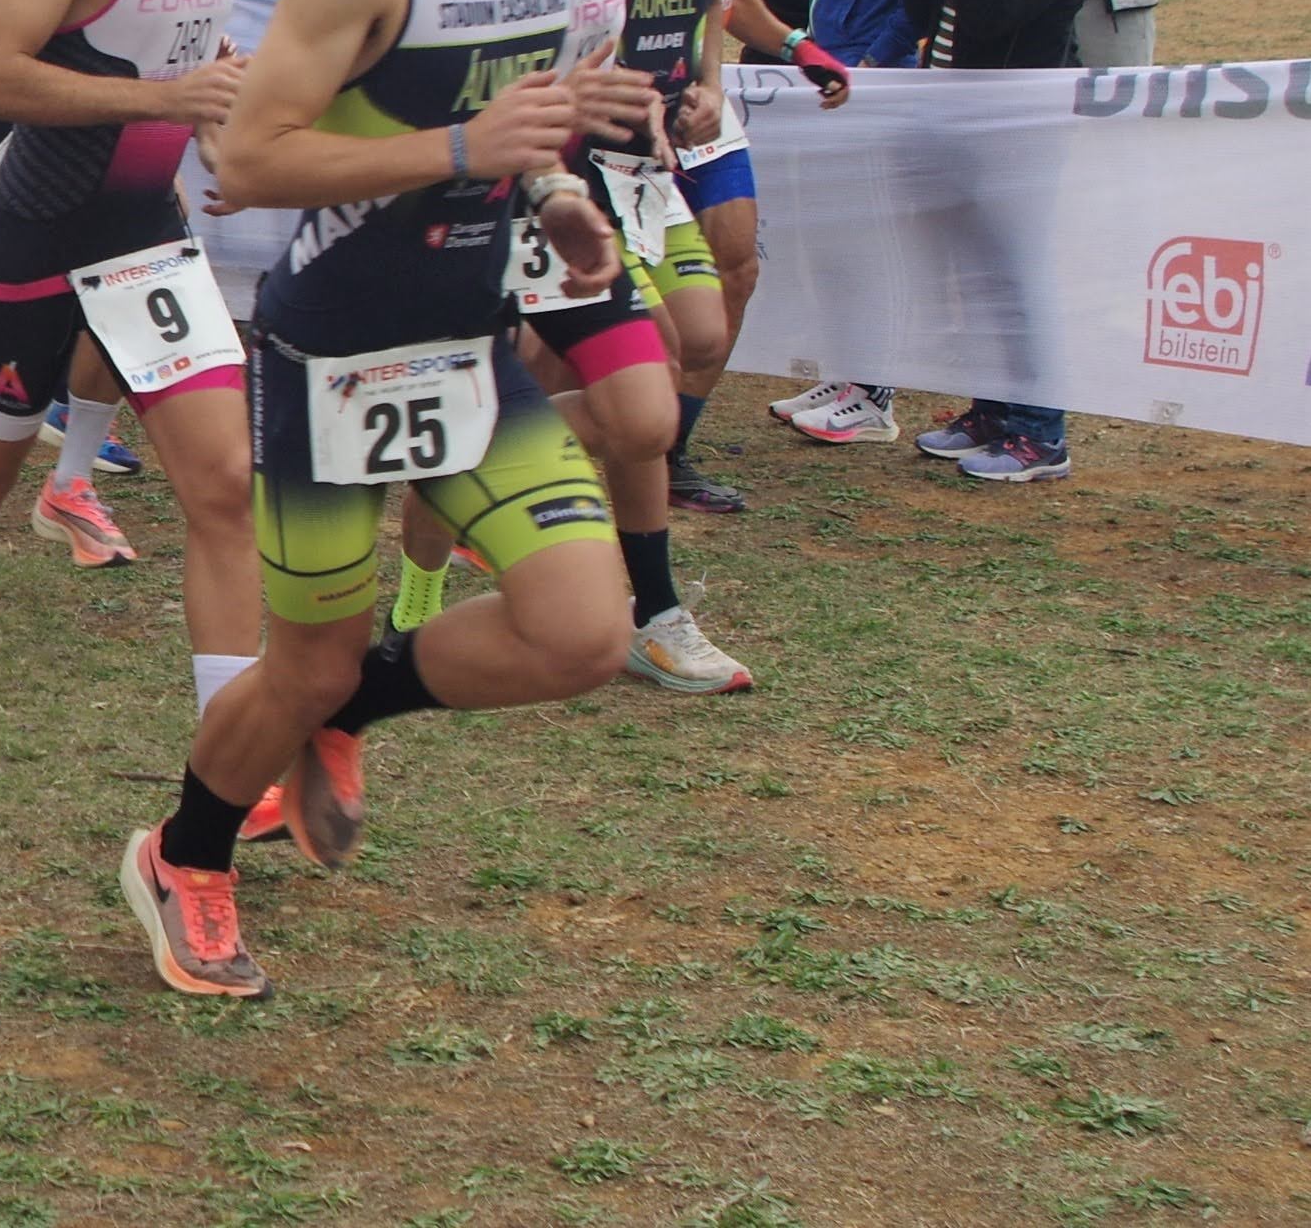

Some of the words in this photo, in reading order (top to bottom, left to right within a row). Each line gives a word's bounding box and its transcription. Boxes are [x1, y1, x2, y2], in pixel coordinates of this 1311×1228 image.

[636, 32, 686, 52] MAPEI
[103, 255, 195, 286] INTERSPORT
[1147, 242, 1263, 335] febi
[146, 287, 191, 344] 9
[1158, 330, 1241, 367] bilstein
[363, 396, 447, 475] 25
